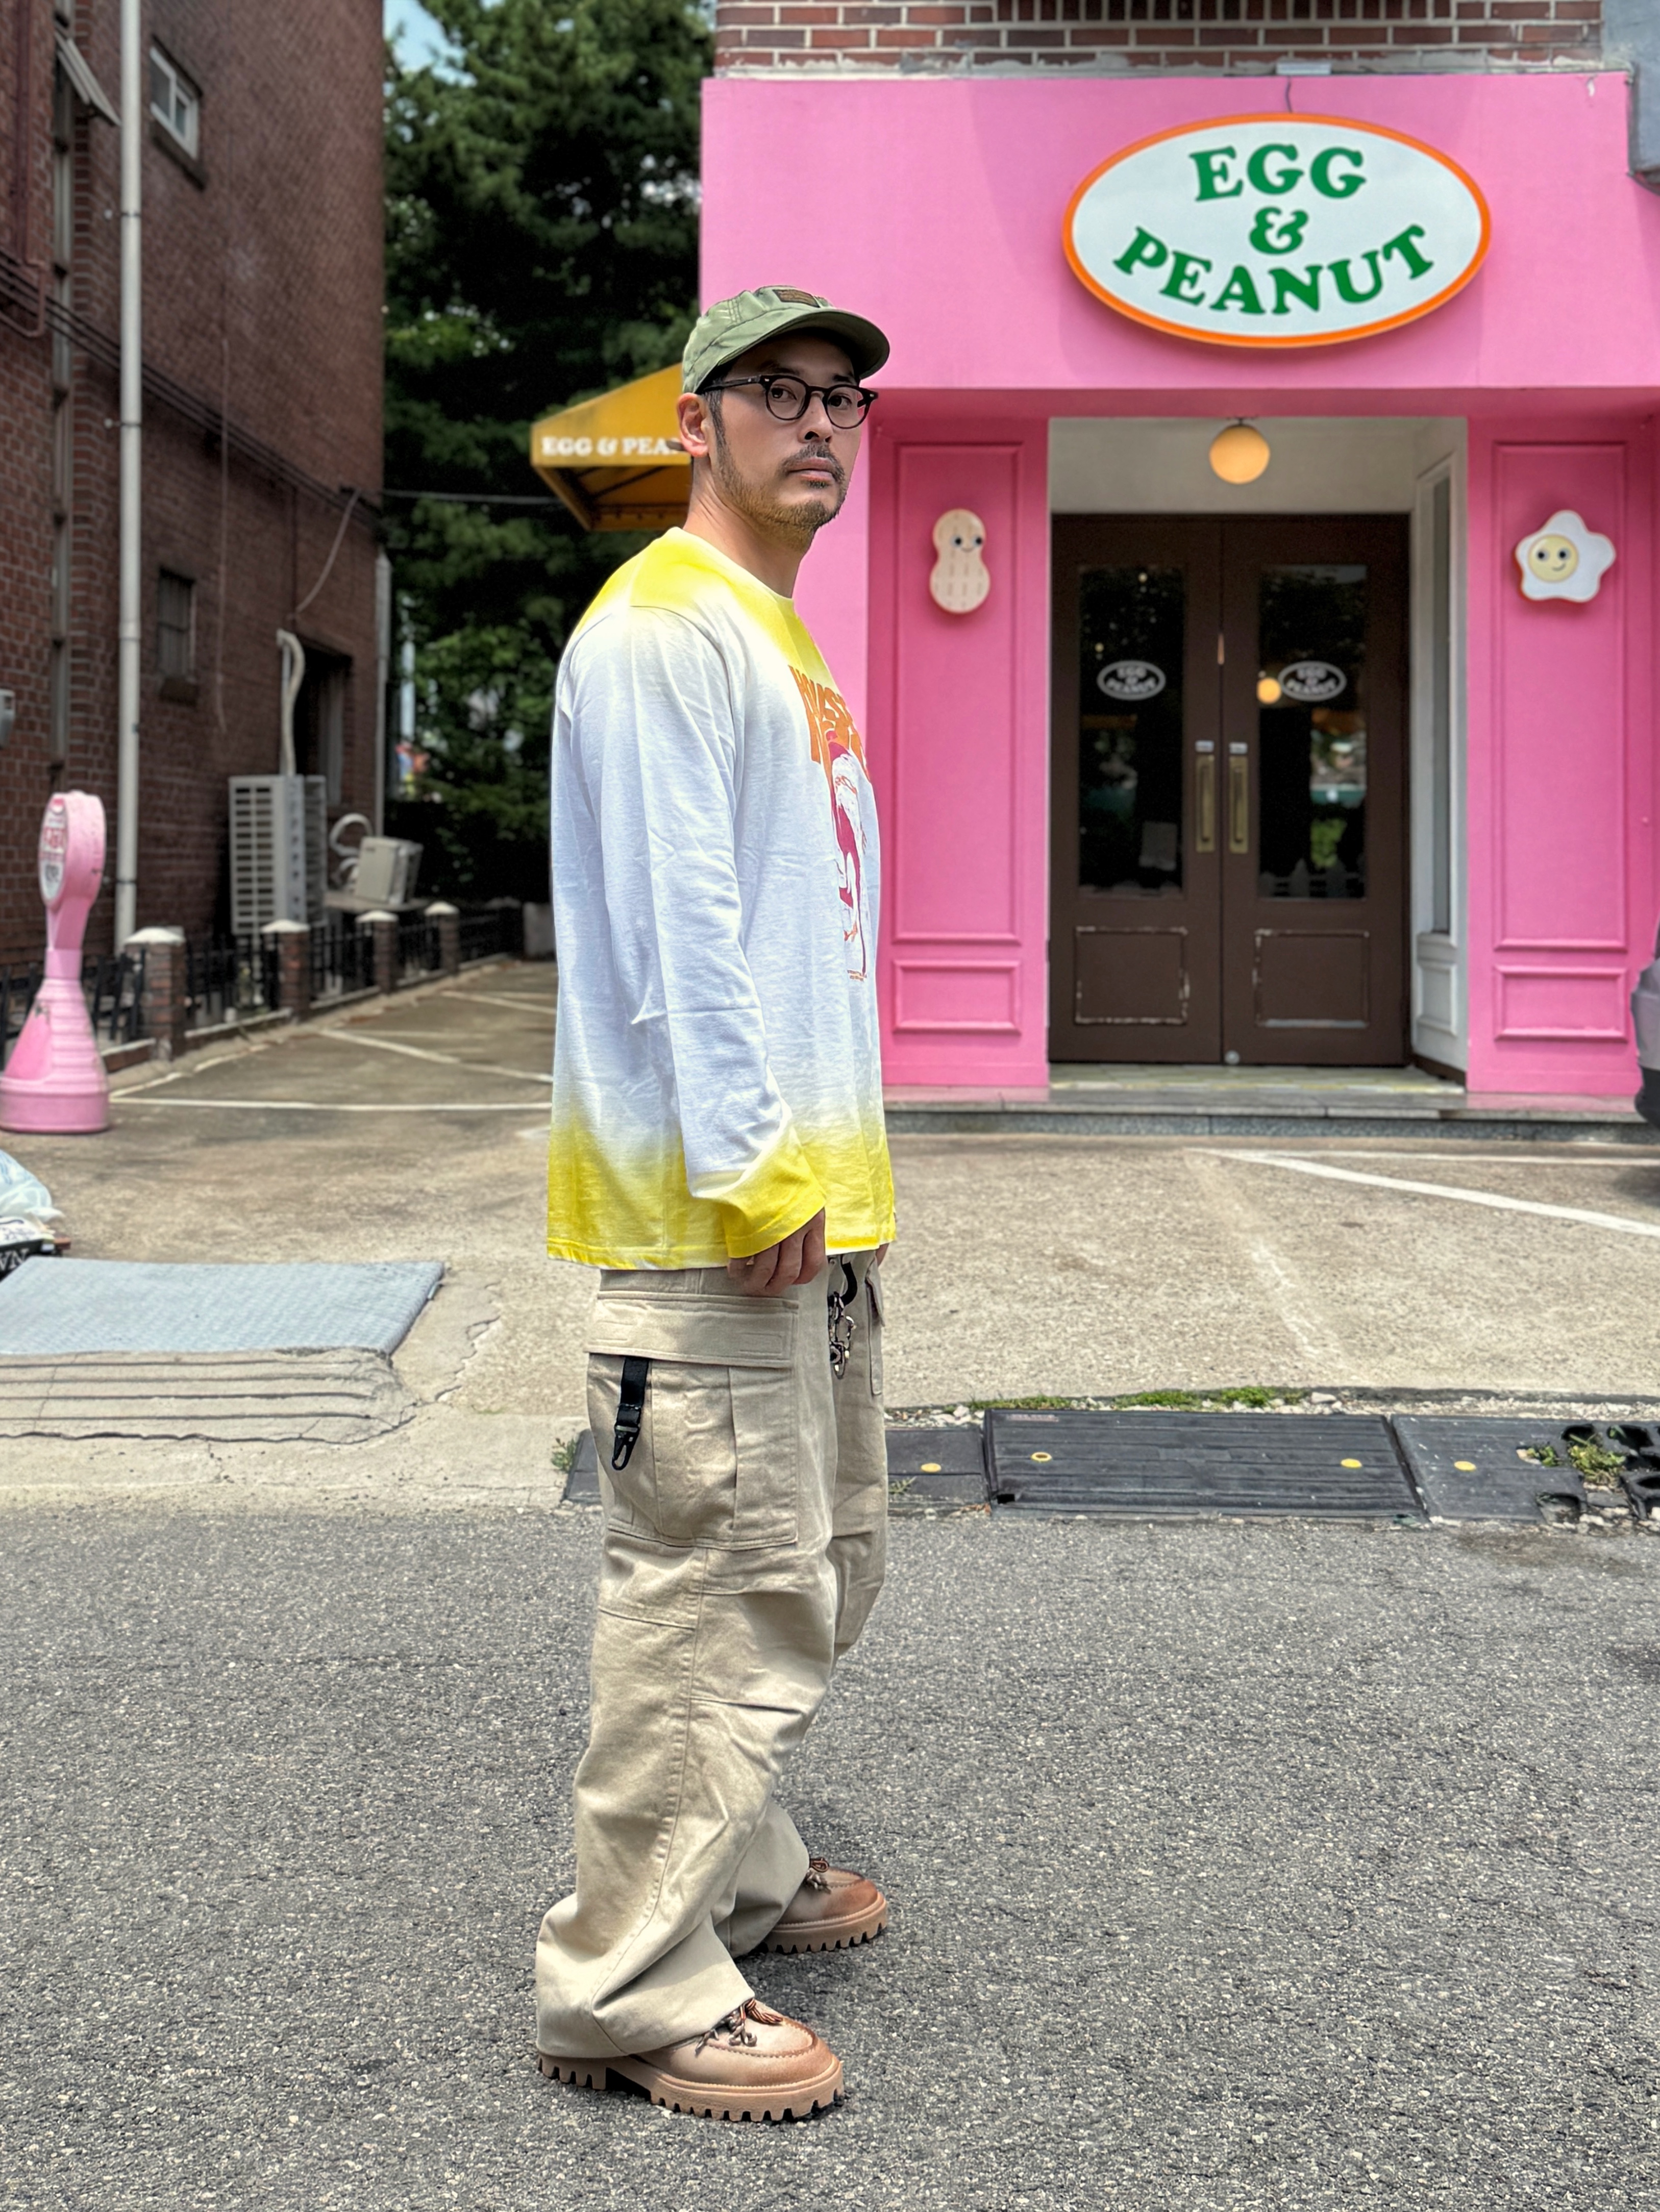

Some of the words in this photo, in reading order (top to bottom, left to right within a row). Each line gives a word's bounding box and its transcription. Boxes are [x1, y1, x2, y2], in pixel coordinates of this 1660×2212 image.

[1189, 143, 1366, 202] EGG
[1249, 207, 1308, 255] &
[1112, 225, 1434, 315] PEANUT
[541, 437, 593, 455] EGG
[597, 437, 618, 456] &
[621, 437, 680, 455] PEA
